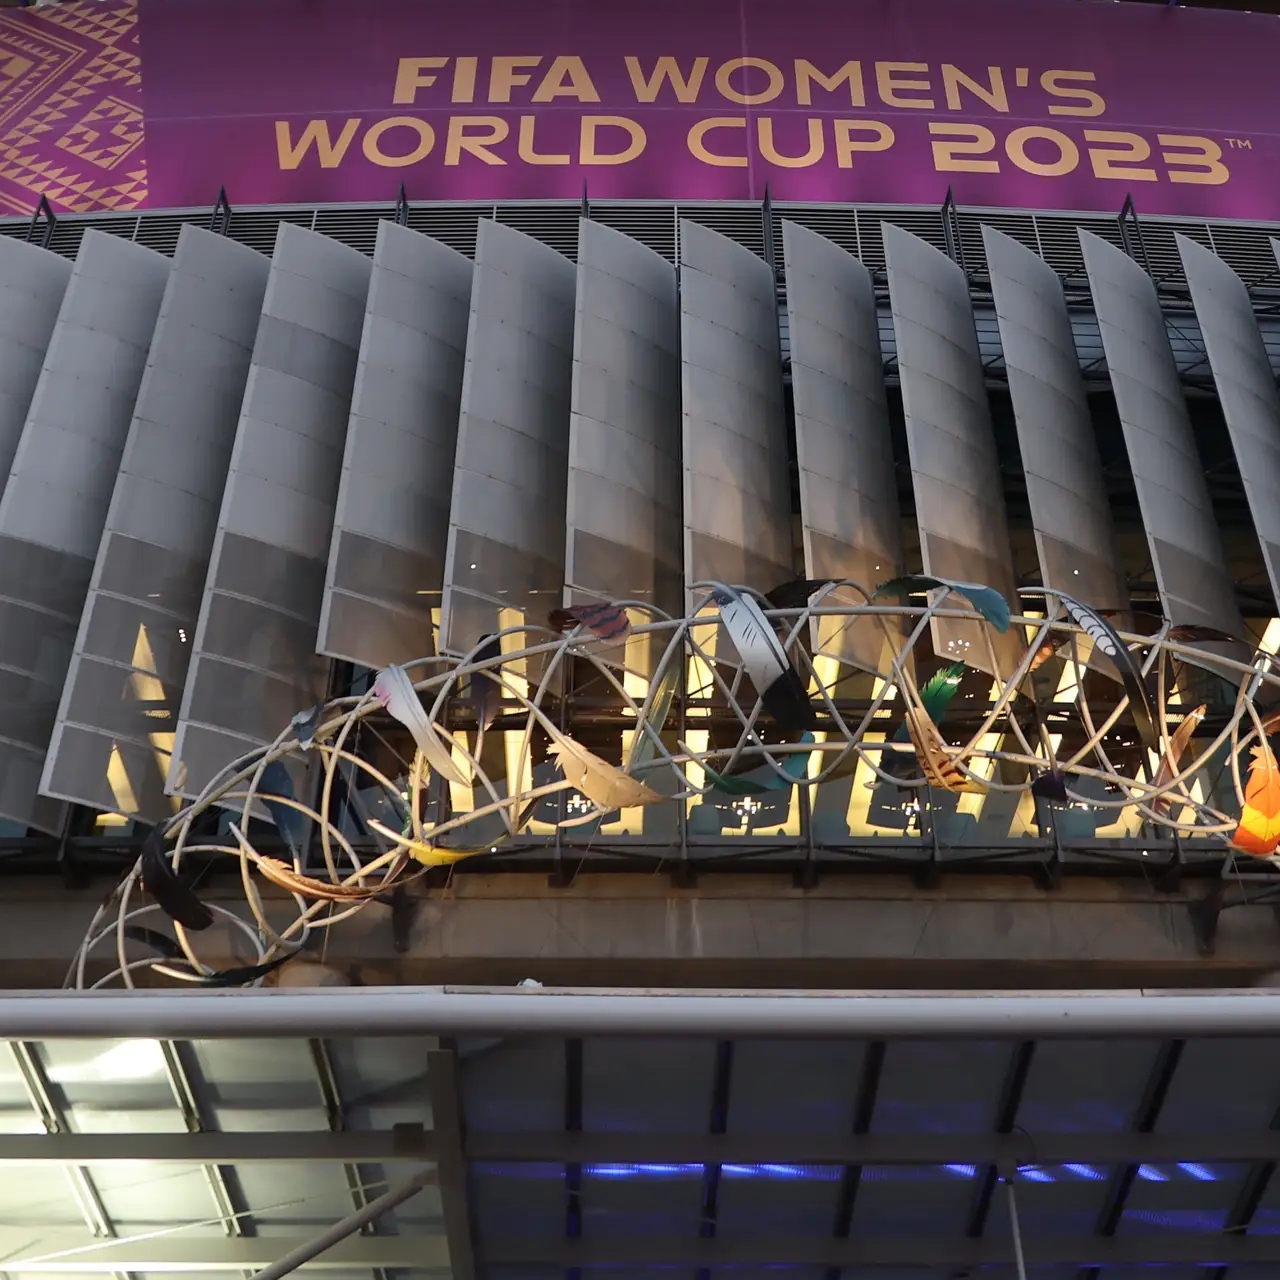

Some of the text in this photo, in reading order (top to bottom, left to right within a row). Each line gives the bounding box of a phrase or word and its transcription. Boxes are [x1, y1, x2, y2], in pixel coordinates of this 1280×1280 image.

[393, 55, 1106, 118] FIFA WOMEN'S
[274, 115, 648, 171] WORLD
[686, 116, 896, 169] CUP
